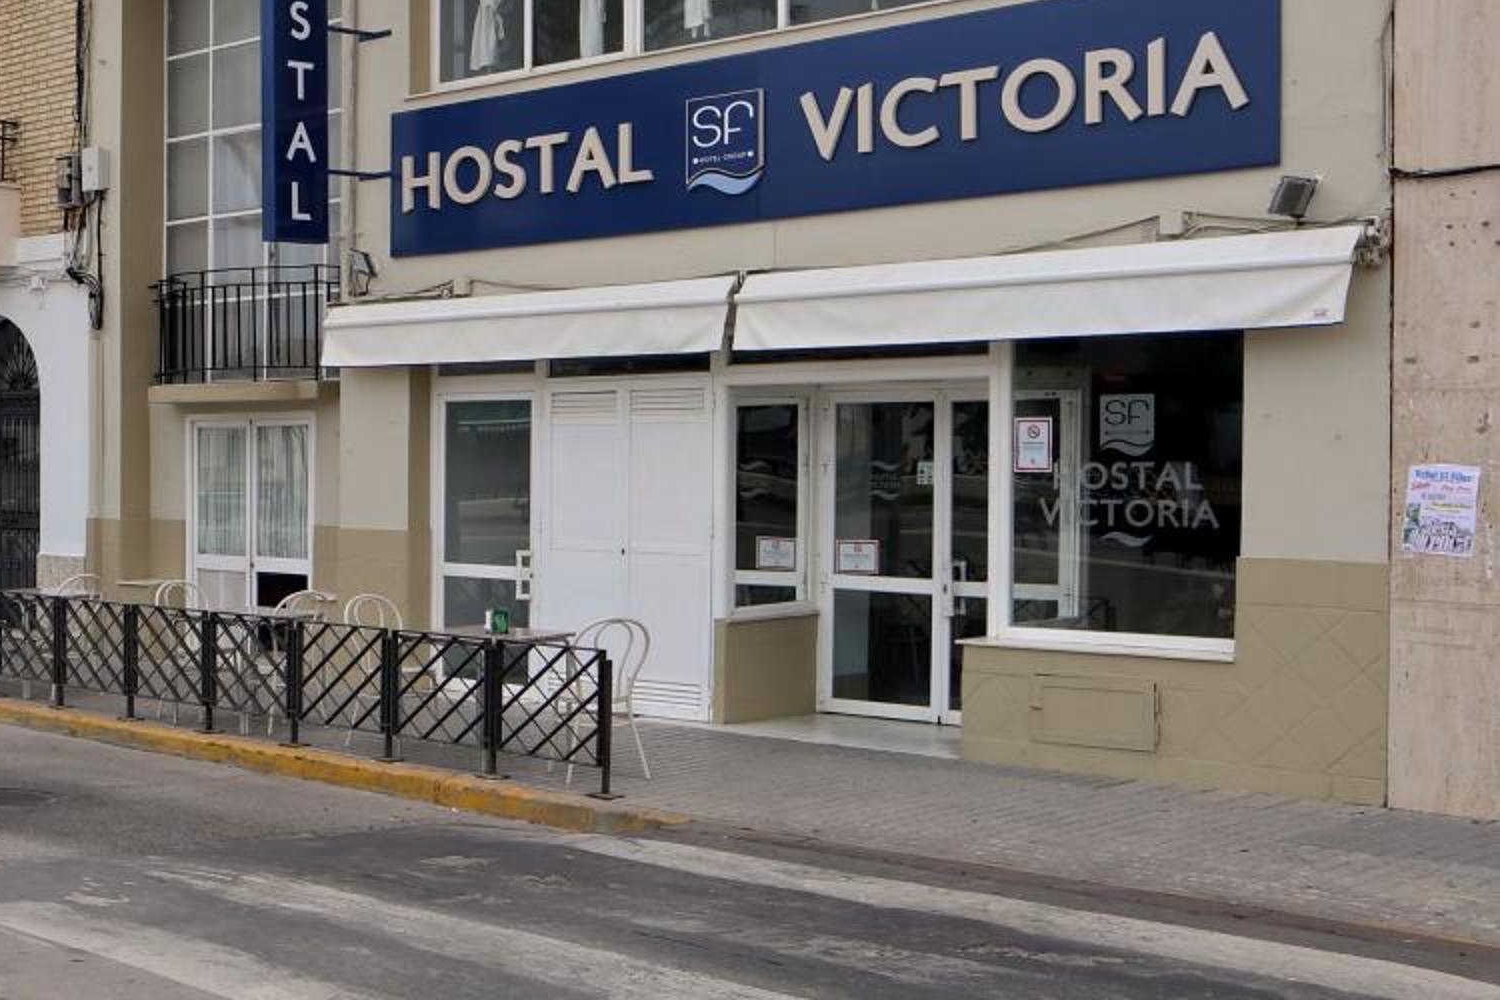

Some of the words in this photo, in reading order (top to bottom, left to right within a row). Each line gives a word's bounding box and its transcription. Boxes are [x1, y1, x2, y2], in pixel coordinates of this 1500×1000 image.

[800, 31, 1250, 161] VICTORIA
[401, 122, 653, 212] HOSTAL
[1040, 497, 1219, 529] VCTORIA
